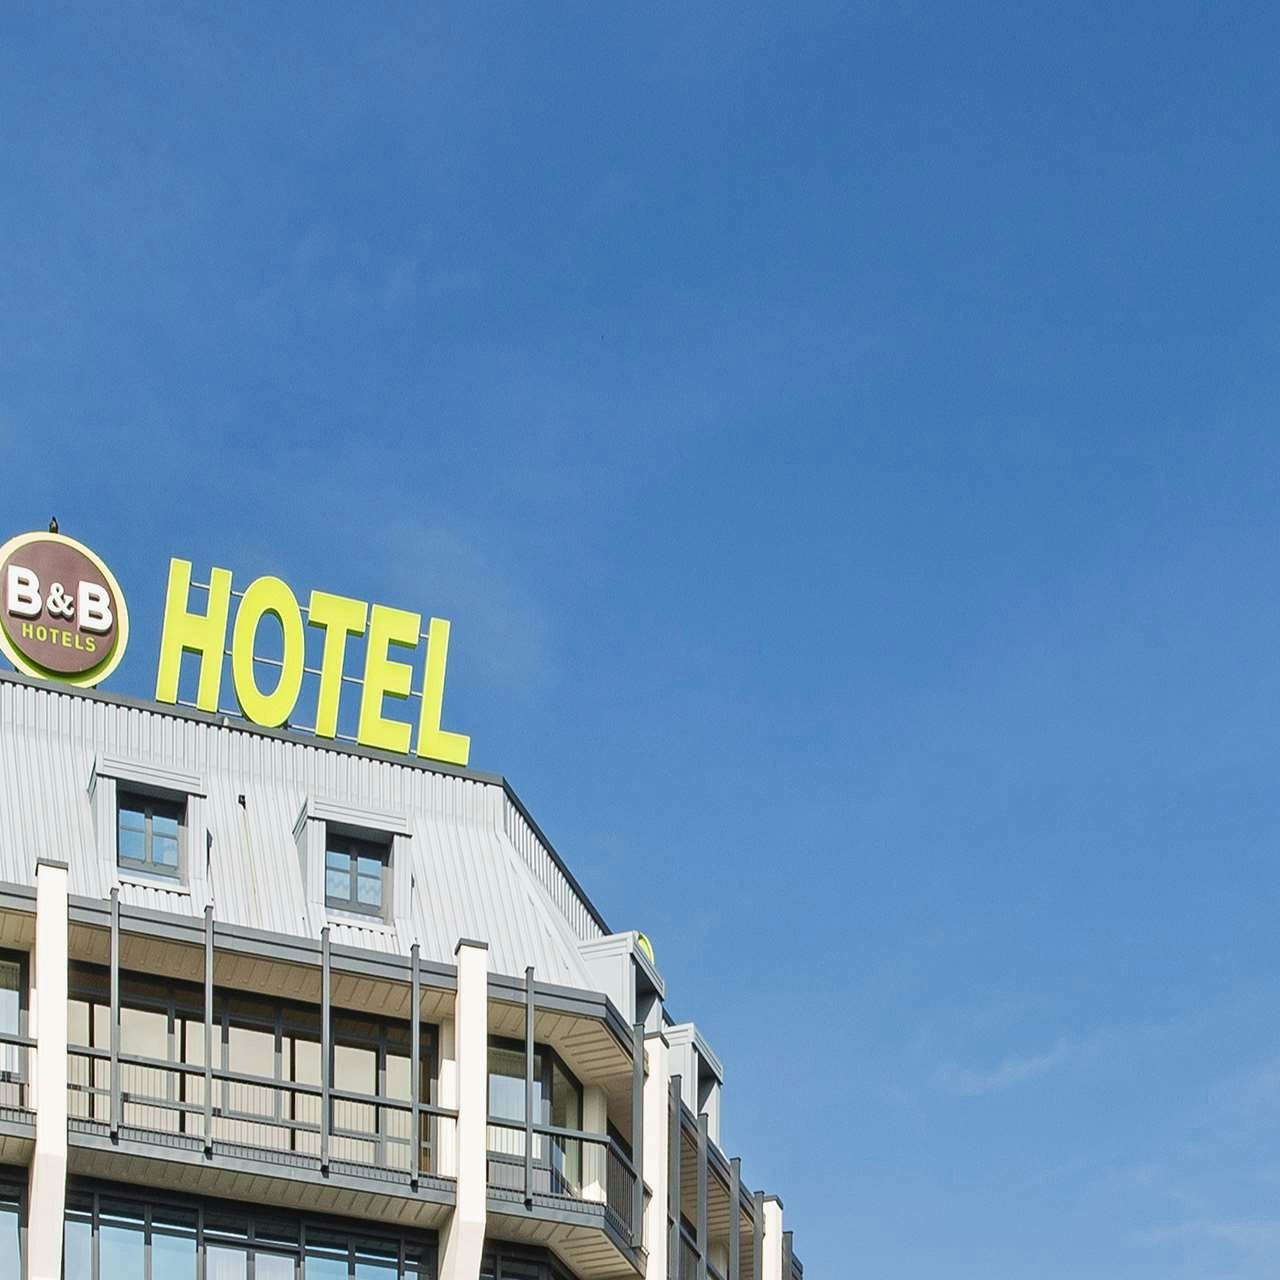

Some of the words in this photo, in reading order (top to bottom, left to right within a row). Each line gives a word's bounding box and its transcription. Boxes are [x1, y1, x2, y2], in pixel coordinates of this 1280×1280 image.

[7, 564, 114, 634] B&B
[21, 623, 97, 653] HOTELS
[156, 557, 471, 766] HOTEL
